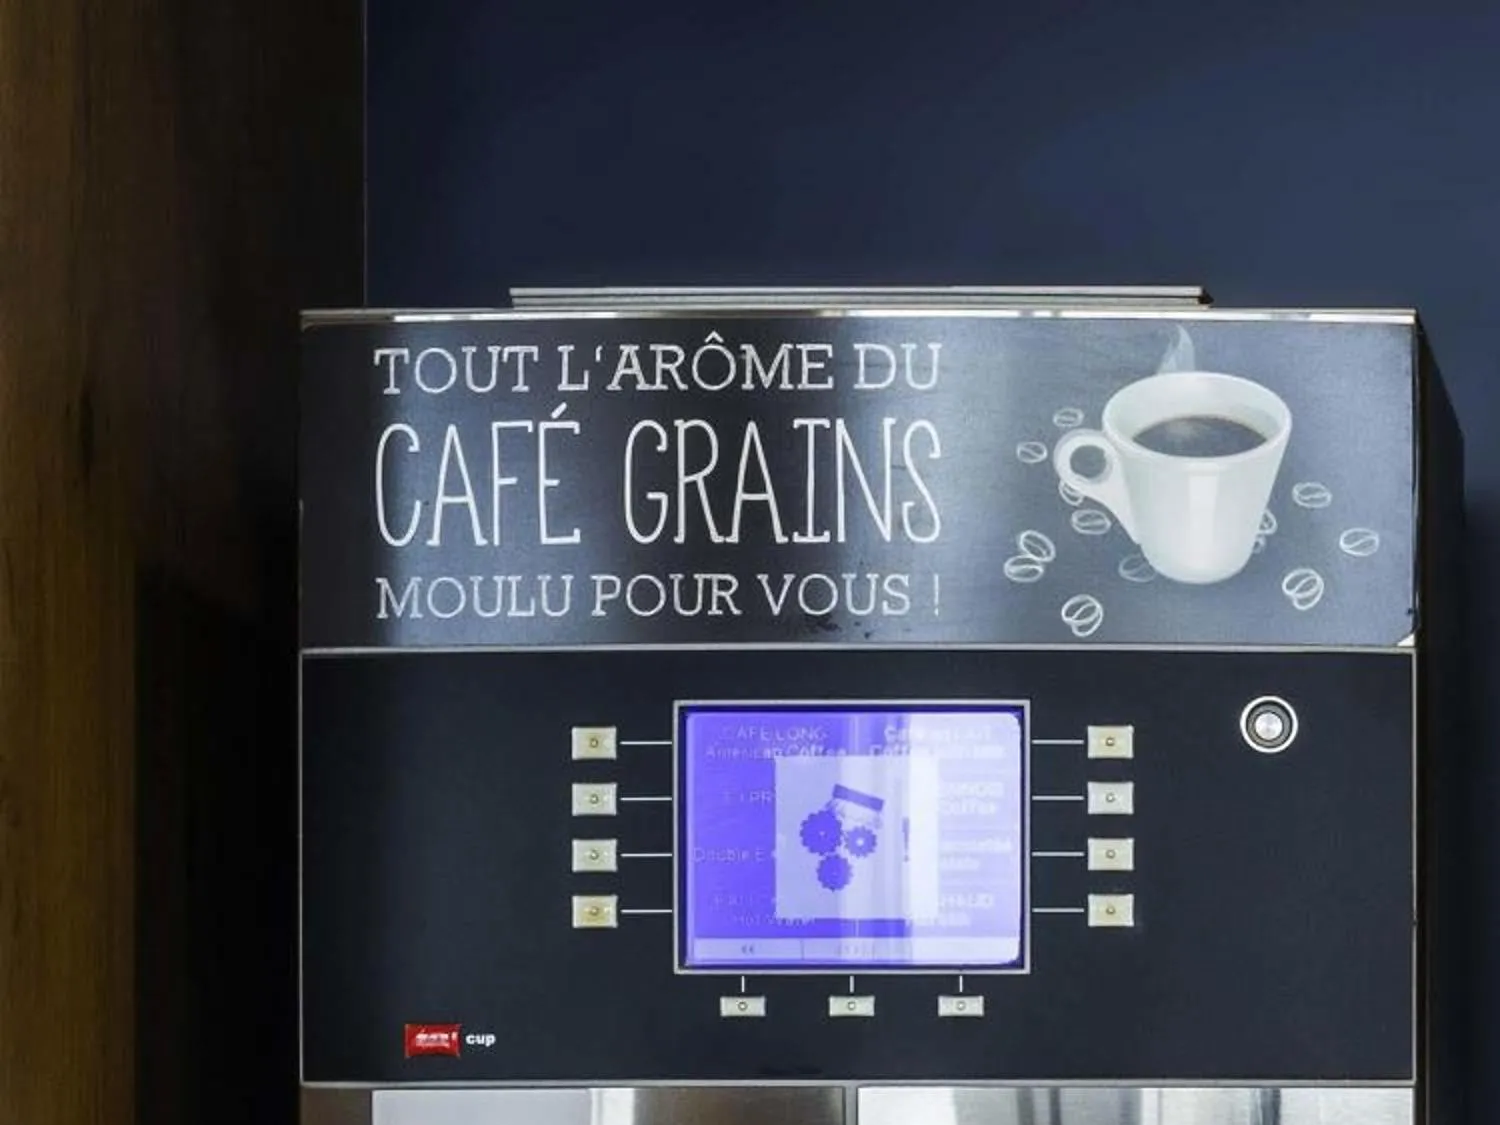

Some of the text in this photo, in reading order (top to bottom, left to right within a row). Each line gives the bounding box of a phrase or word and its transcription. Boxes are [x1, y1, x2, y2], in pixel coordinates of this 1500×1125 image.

[374, 331, 942, 394] TOUT L'ARÔME DU
[375, 402, 942, 547] CAFÉ GRAINS
[375, 576, 573, 619] MOULU
[591, 574, 743, 617] POUR
[757, 573, 912, 616] VOUS
[465, 1033, 497, 1047] cup
